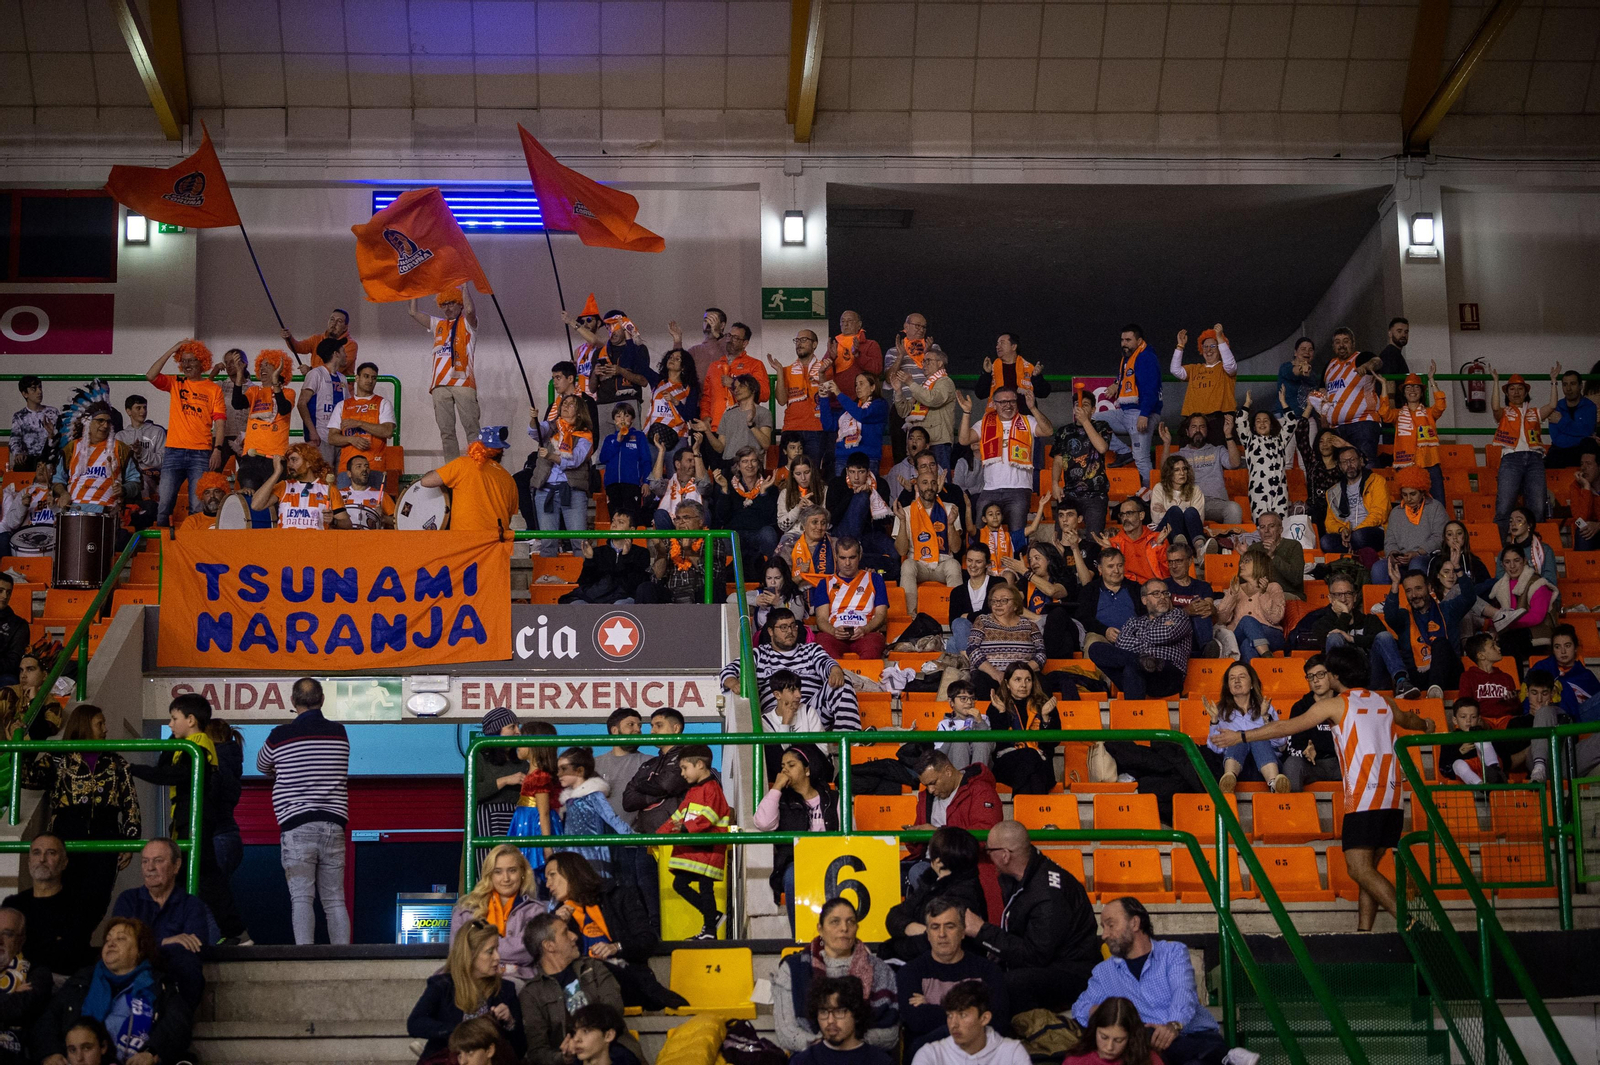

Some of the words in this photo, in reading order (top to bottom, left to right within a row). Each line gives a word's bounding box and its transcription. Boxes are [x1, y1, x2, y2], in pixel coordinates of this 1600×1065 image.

[355, 404, 369, 413] 72
[286, 508, 311, 518] LEYMA
[286, 517, 320, 527] natura
[195, 563, 478, 603] TSUNAMI
[196, 605, 487, 655] NARANJA
[461, 681, 705, 711] EMERXENCIA
[1119, 860, 1132, 868] 61
[824, 855, 871, 924] 6
[413, 919, 449, 929] opcorn
[705, 964, 721, 974] 74
